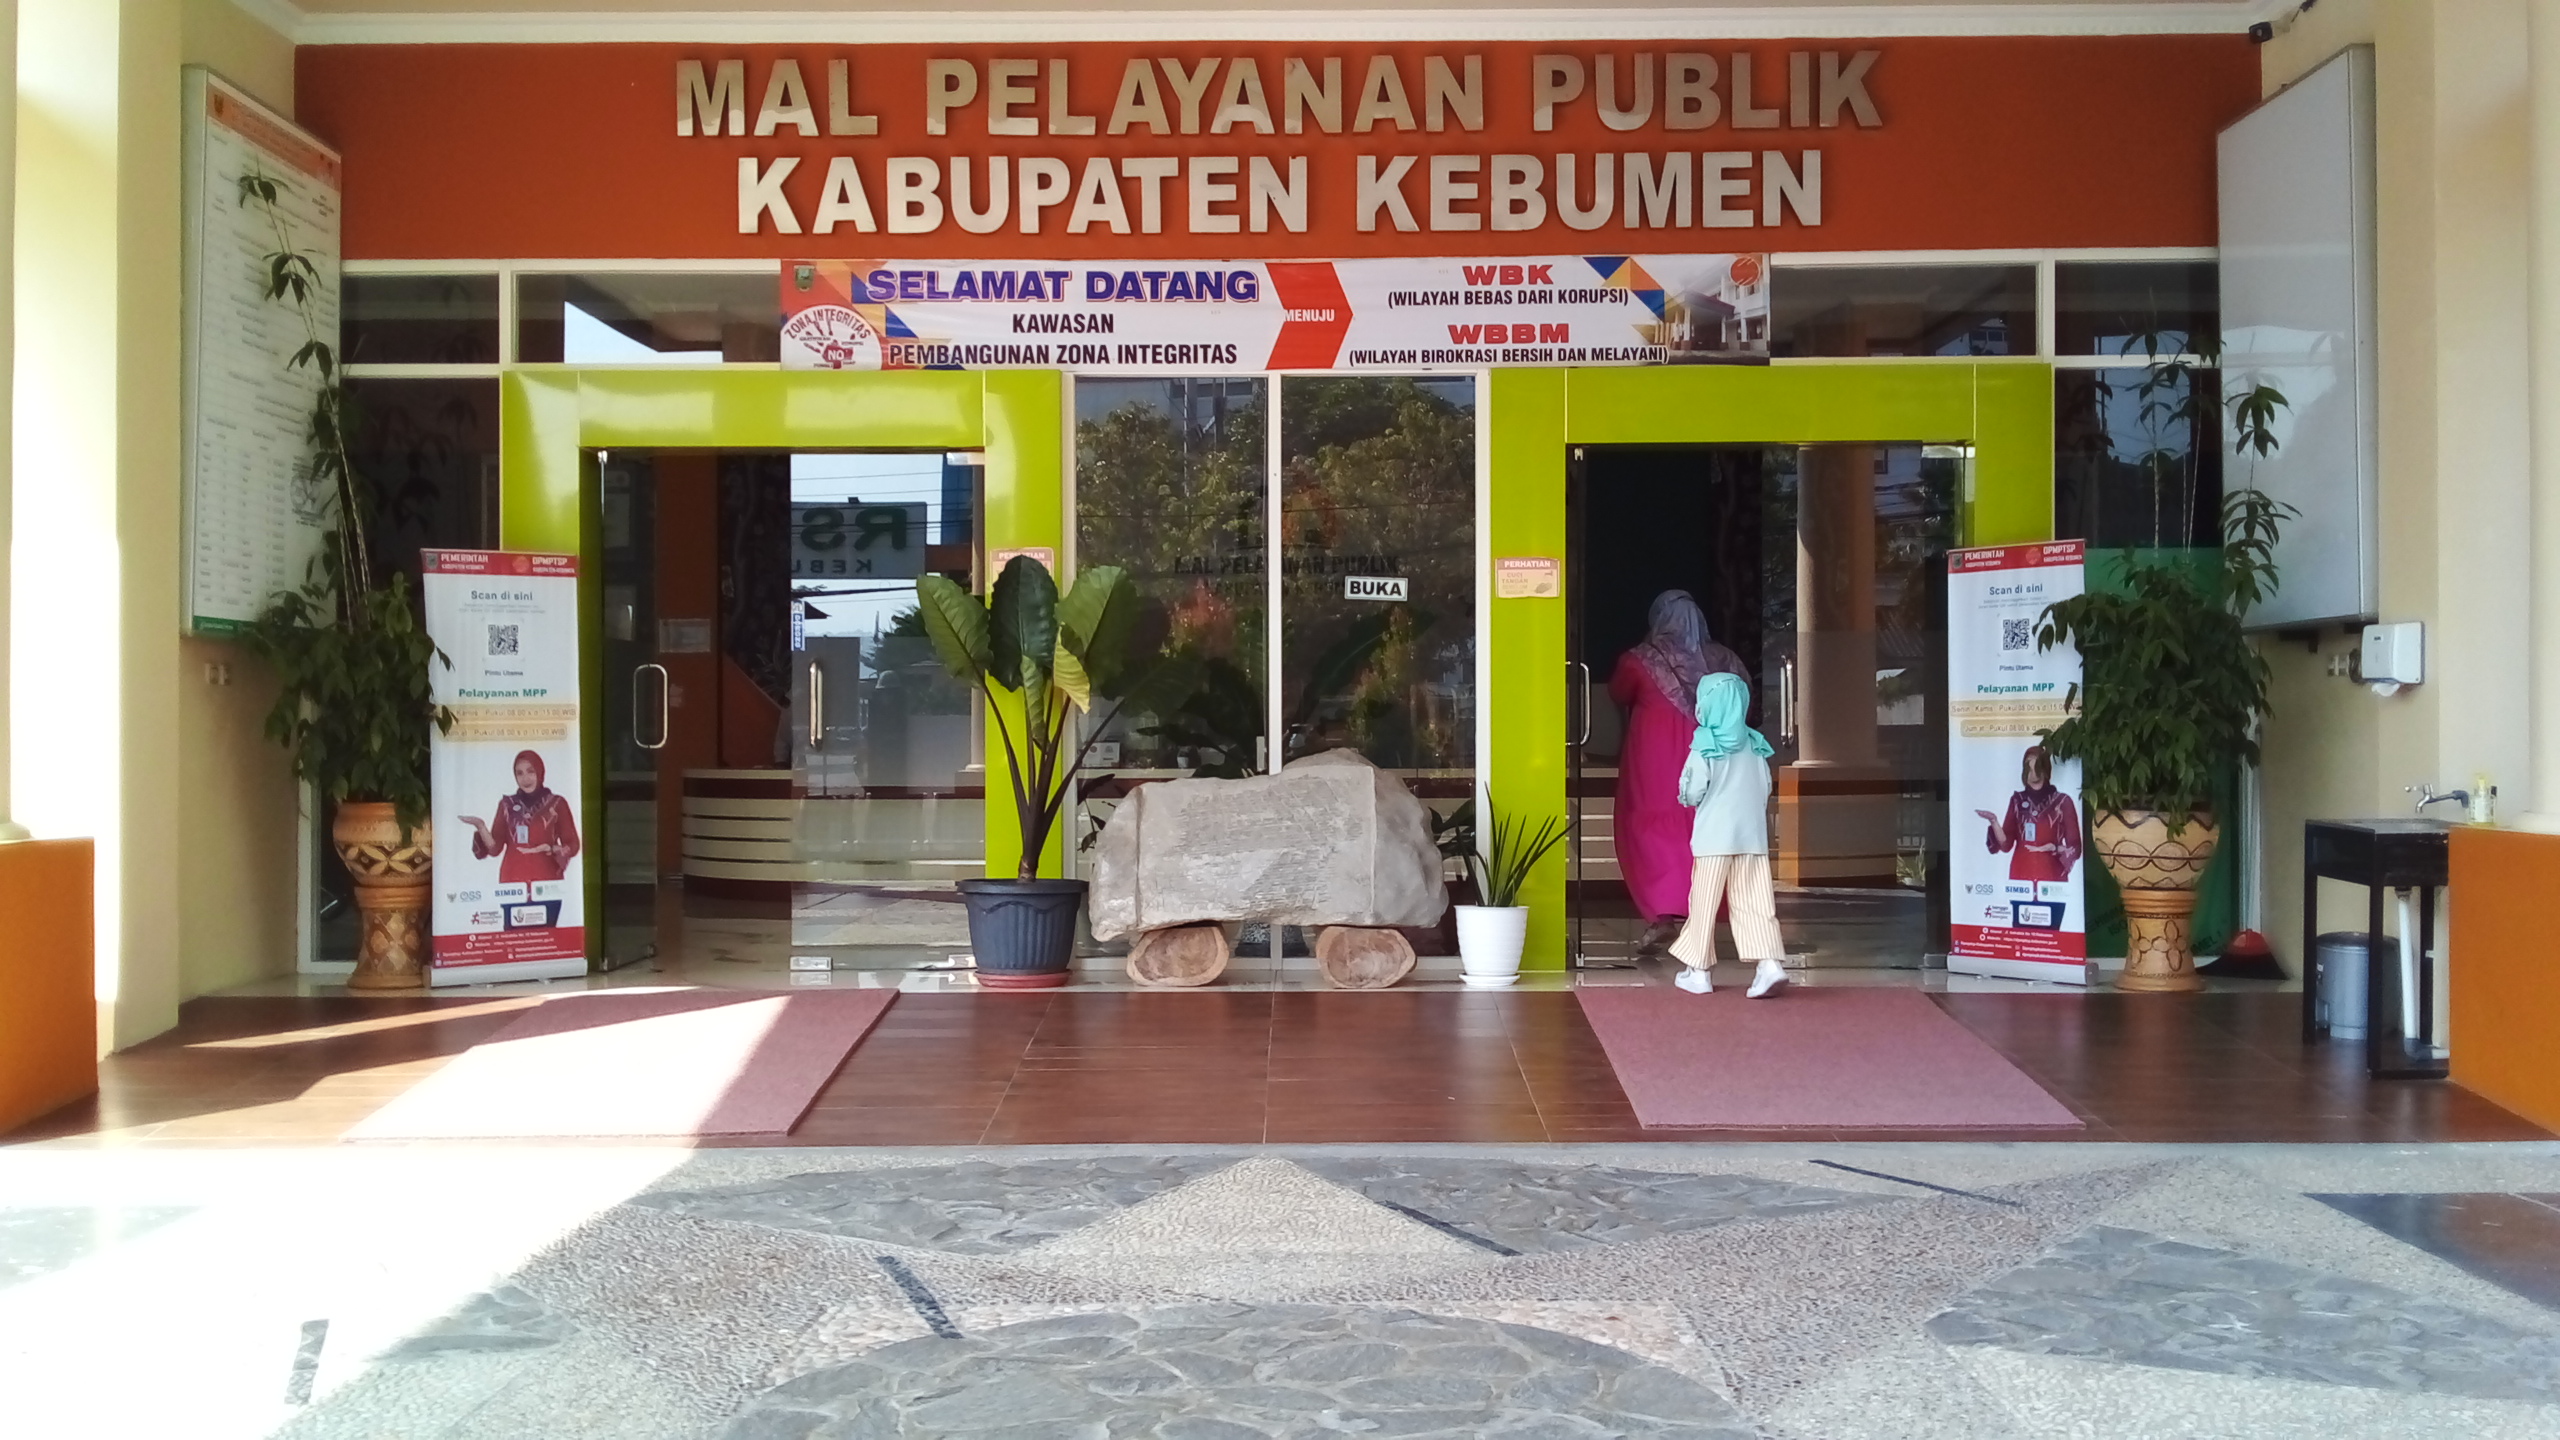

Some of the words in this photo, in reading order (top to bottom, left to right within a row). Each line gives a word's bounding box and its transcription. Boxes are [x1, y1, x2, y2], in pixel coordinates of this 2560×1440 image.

[676, 58, 878, 137] MAL
[926, 54, 1484, 136] PELAYANAN
[1533, 50, 1882, 131] PUBLIK
[738, 155, 1308, 234] KABUPATEN
[1356, 150, 1822, 232] KEBUMEN
[1462, 265, 1554, 286] WBK
[867, 270, 1073, 302] SELAMAT
[1086, 270, 1260, 302] DATANG
[1388, 291, 1459, 309] (WILAYAH
[1464, 290, 1513, 306] BEBAS
[1518, 289, 1552, 304] DARI
[1558, 288, 1629, 306] KORUPSI)
[1284, 309, 1335, 322] MENUJU
[784, 314, 814, 339] ZONA
[812, 308, 871, 339] INTEGRITAS
[1013, 313, 1114, 334] KAWASAN
[1447, 323, 1570, 345] WBBM
[827, 349, 845, 361] NO
[890, 344, 1049, 365] PEMBANGUNAN
[1056, 344, 1110, 365] ZONA
[1117, 343, 1238, 365] INTEGRITAS
[1349, 350, 1417, 367] (WILAYAH
[1421, 349, 1497, 364] BIROKRASI
[1502, 348, 1551, 362] BERSIH
[1558, 348, 1589, 362] DAN
[1591, 346, 1669, 364] MELAYANI)
[441, 553, 489, 563] PEMERINTAH
[1965, 550, 2005, 560] PEMERINTAH
[1504, 560, 1551, 568] PERHATIAN
[471, 590, 497, 600] Scan
[500, 590, 510, 600] di
[514, 591, 533, 600] sini
[1349, 580, 1402, 597] BUKA
[1989, 586, 2012, 596] Scan
[2015, 585, 2023, 594] di
[2026, 584, 2043, 593] sini
[458, 688, 519, 699] Pelayanan
[522, 688, 548, 698] MPP
[1977, 684, 2029, 695] Pelayanan
[2032, 683, 2055, 692] MPP
[1952, 705, 1970, 713] Senin
[2000, 704, 2017, 712] Pukul
[1975, 884, 1994, 894] OSS
[2005, 886, 2030, 894] SIMBG
